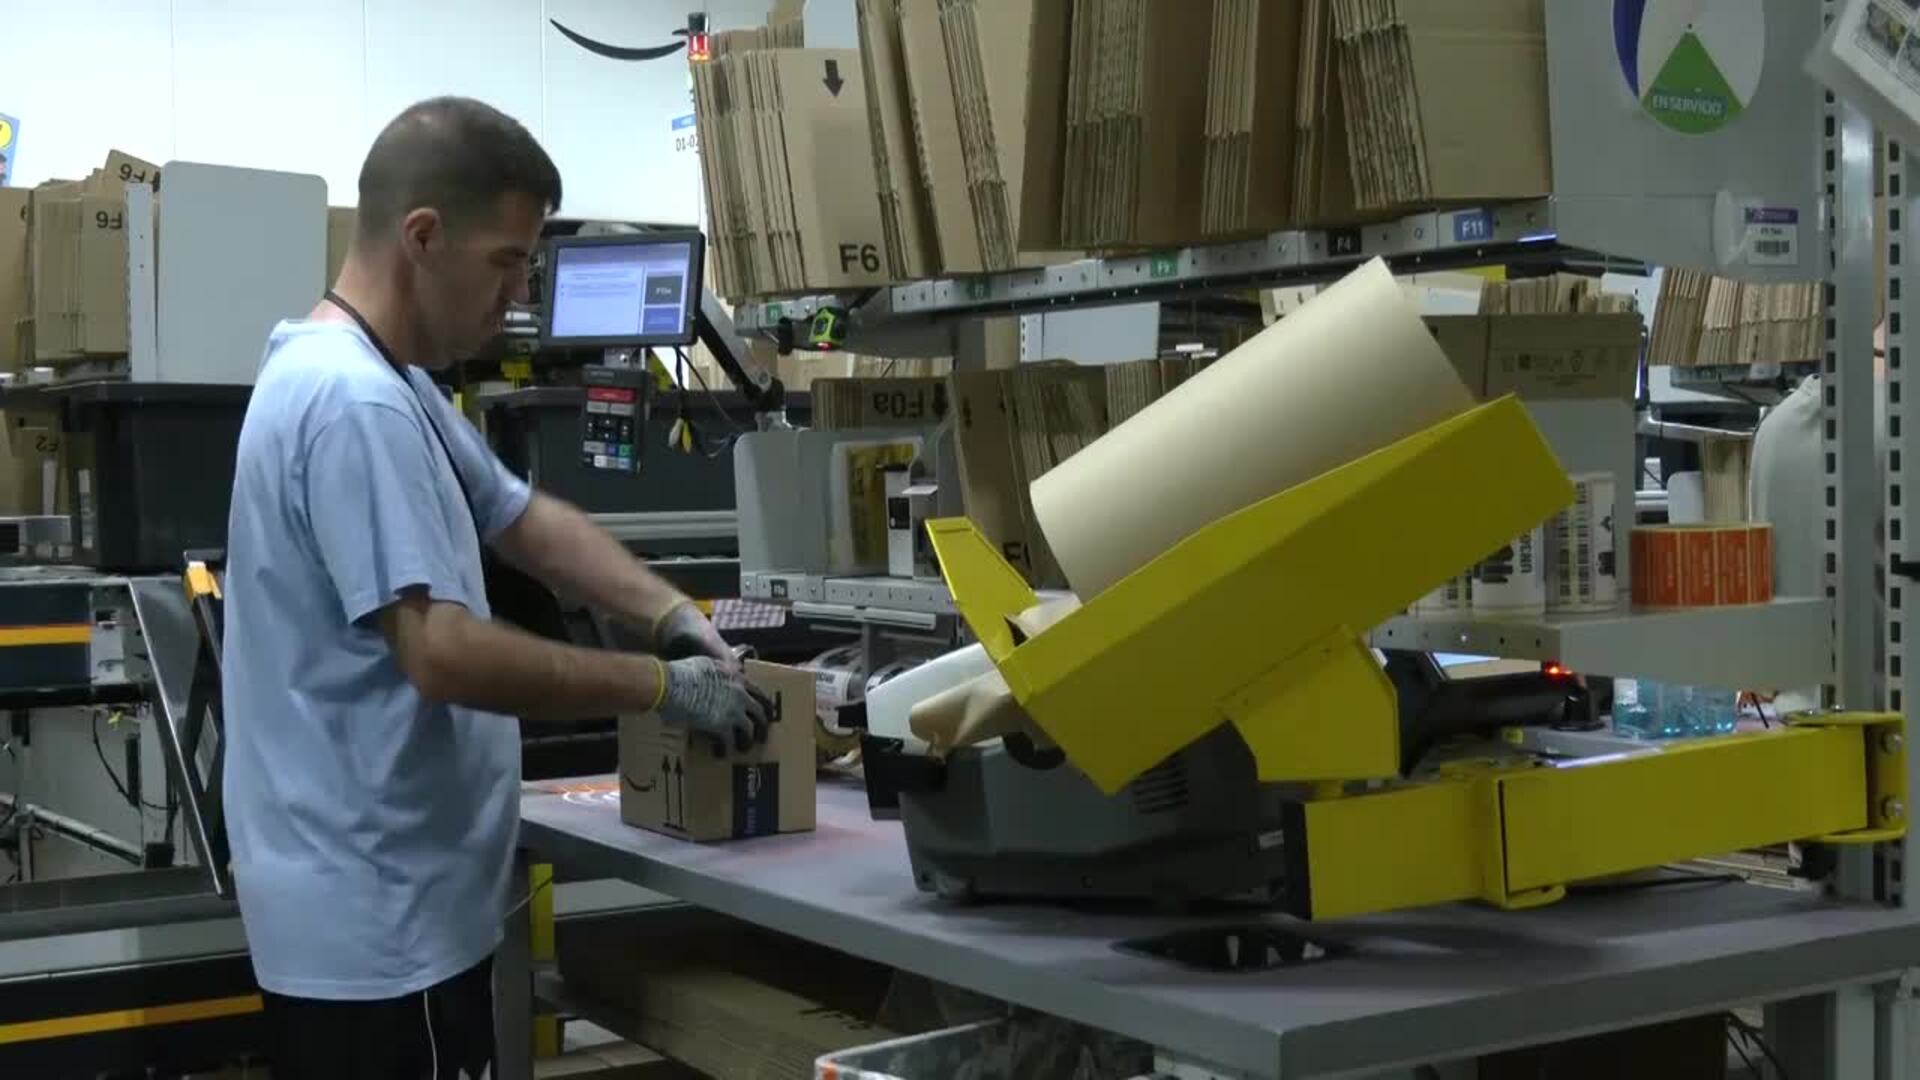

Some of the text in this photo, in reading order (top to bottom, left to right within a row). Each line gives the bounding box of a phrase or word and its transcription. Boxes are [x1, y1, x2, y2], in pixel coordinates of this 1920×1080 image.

[1462, 220, 1484, 238] F11
[838, 244, 881, 274] F6
[872, 389, 925, 419] F0a
